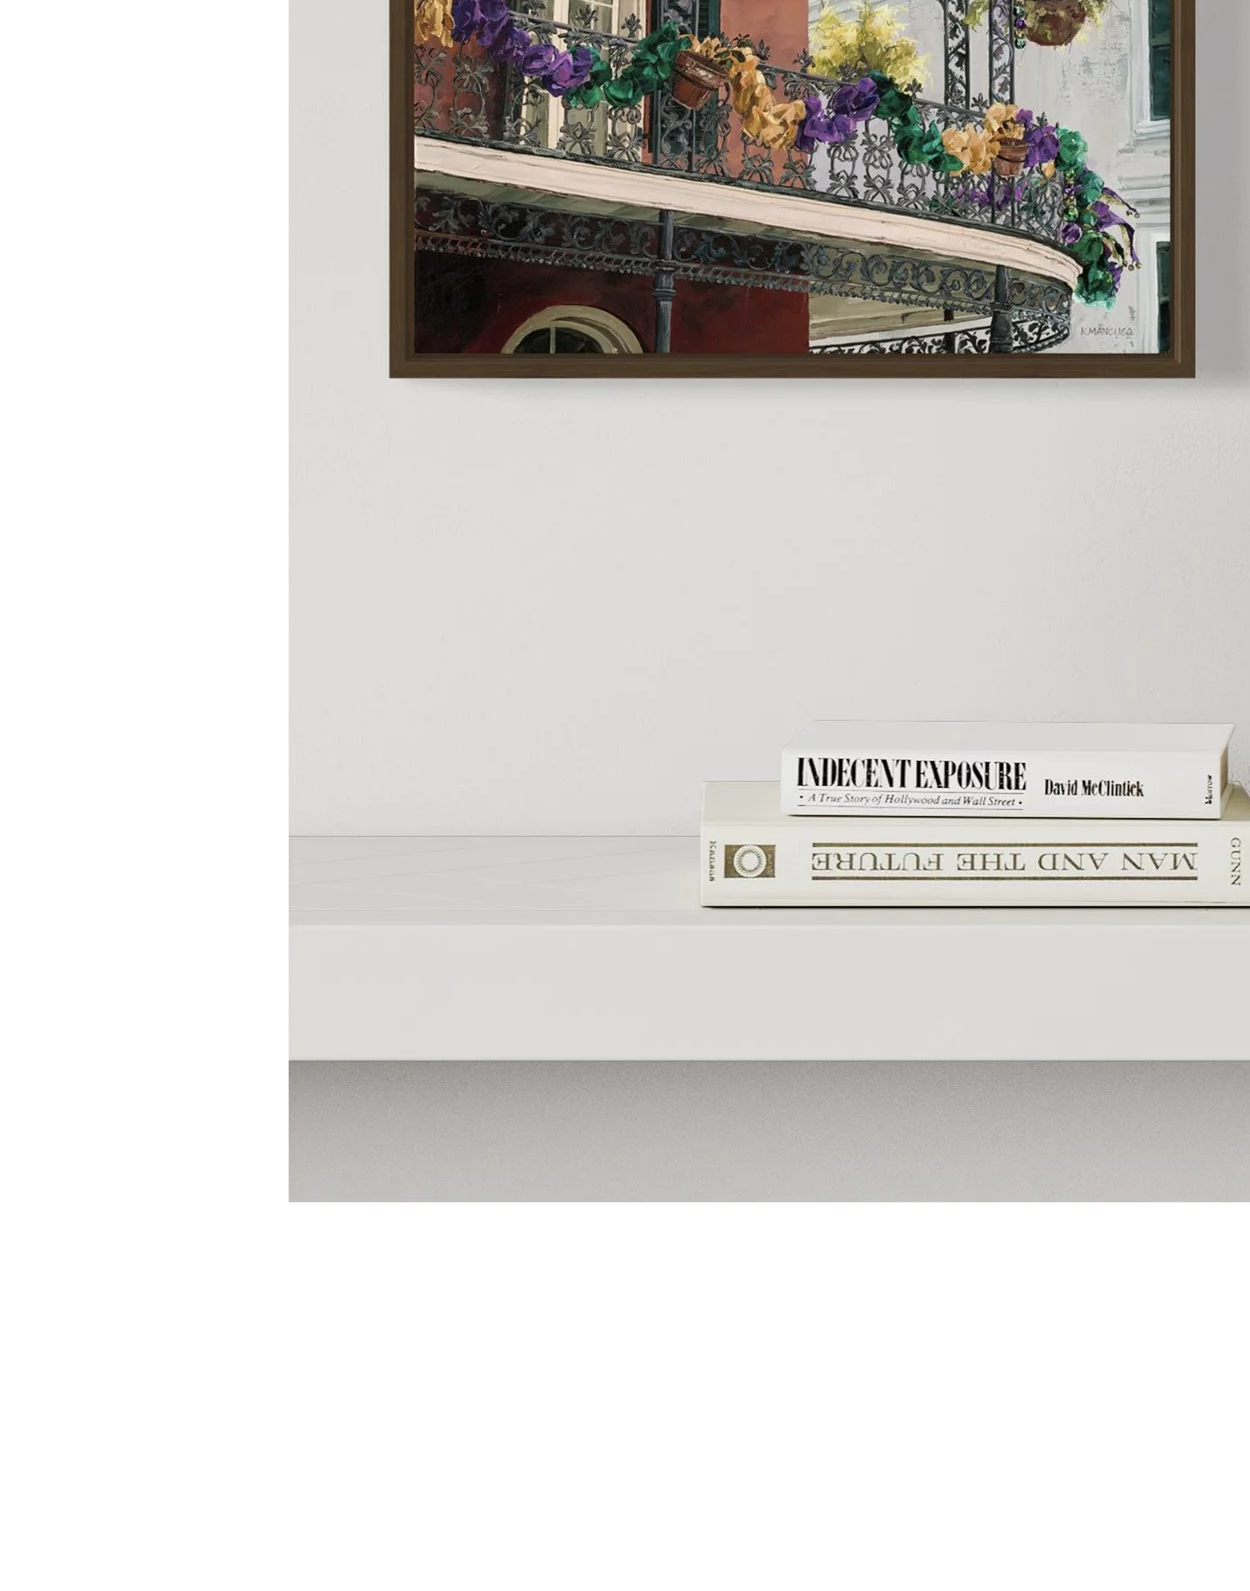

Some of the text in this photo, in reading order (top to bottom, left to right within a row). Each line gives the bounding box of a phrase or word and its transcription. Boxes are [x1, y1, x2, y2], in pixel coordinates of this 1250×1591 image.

[796, 757, 1027, 791] INDECENT EXPOSURE
[1044, 779, 1145, 797] David McClintick
[807, 793, 1016, 807] A True Story of Hollywood and Wall Street
[811, 852, 1198, 871] MAN AND THE FUTURE
[1230, 837, 1241, 886] GUNN
